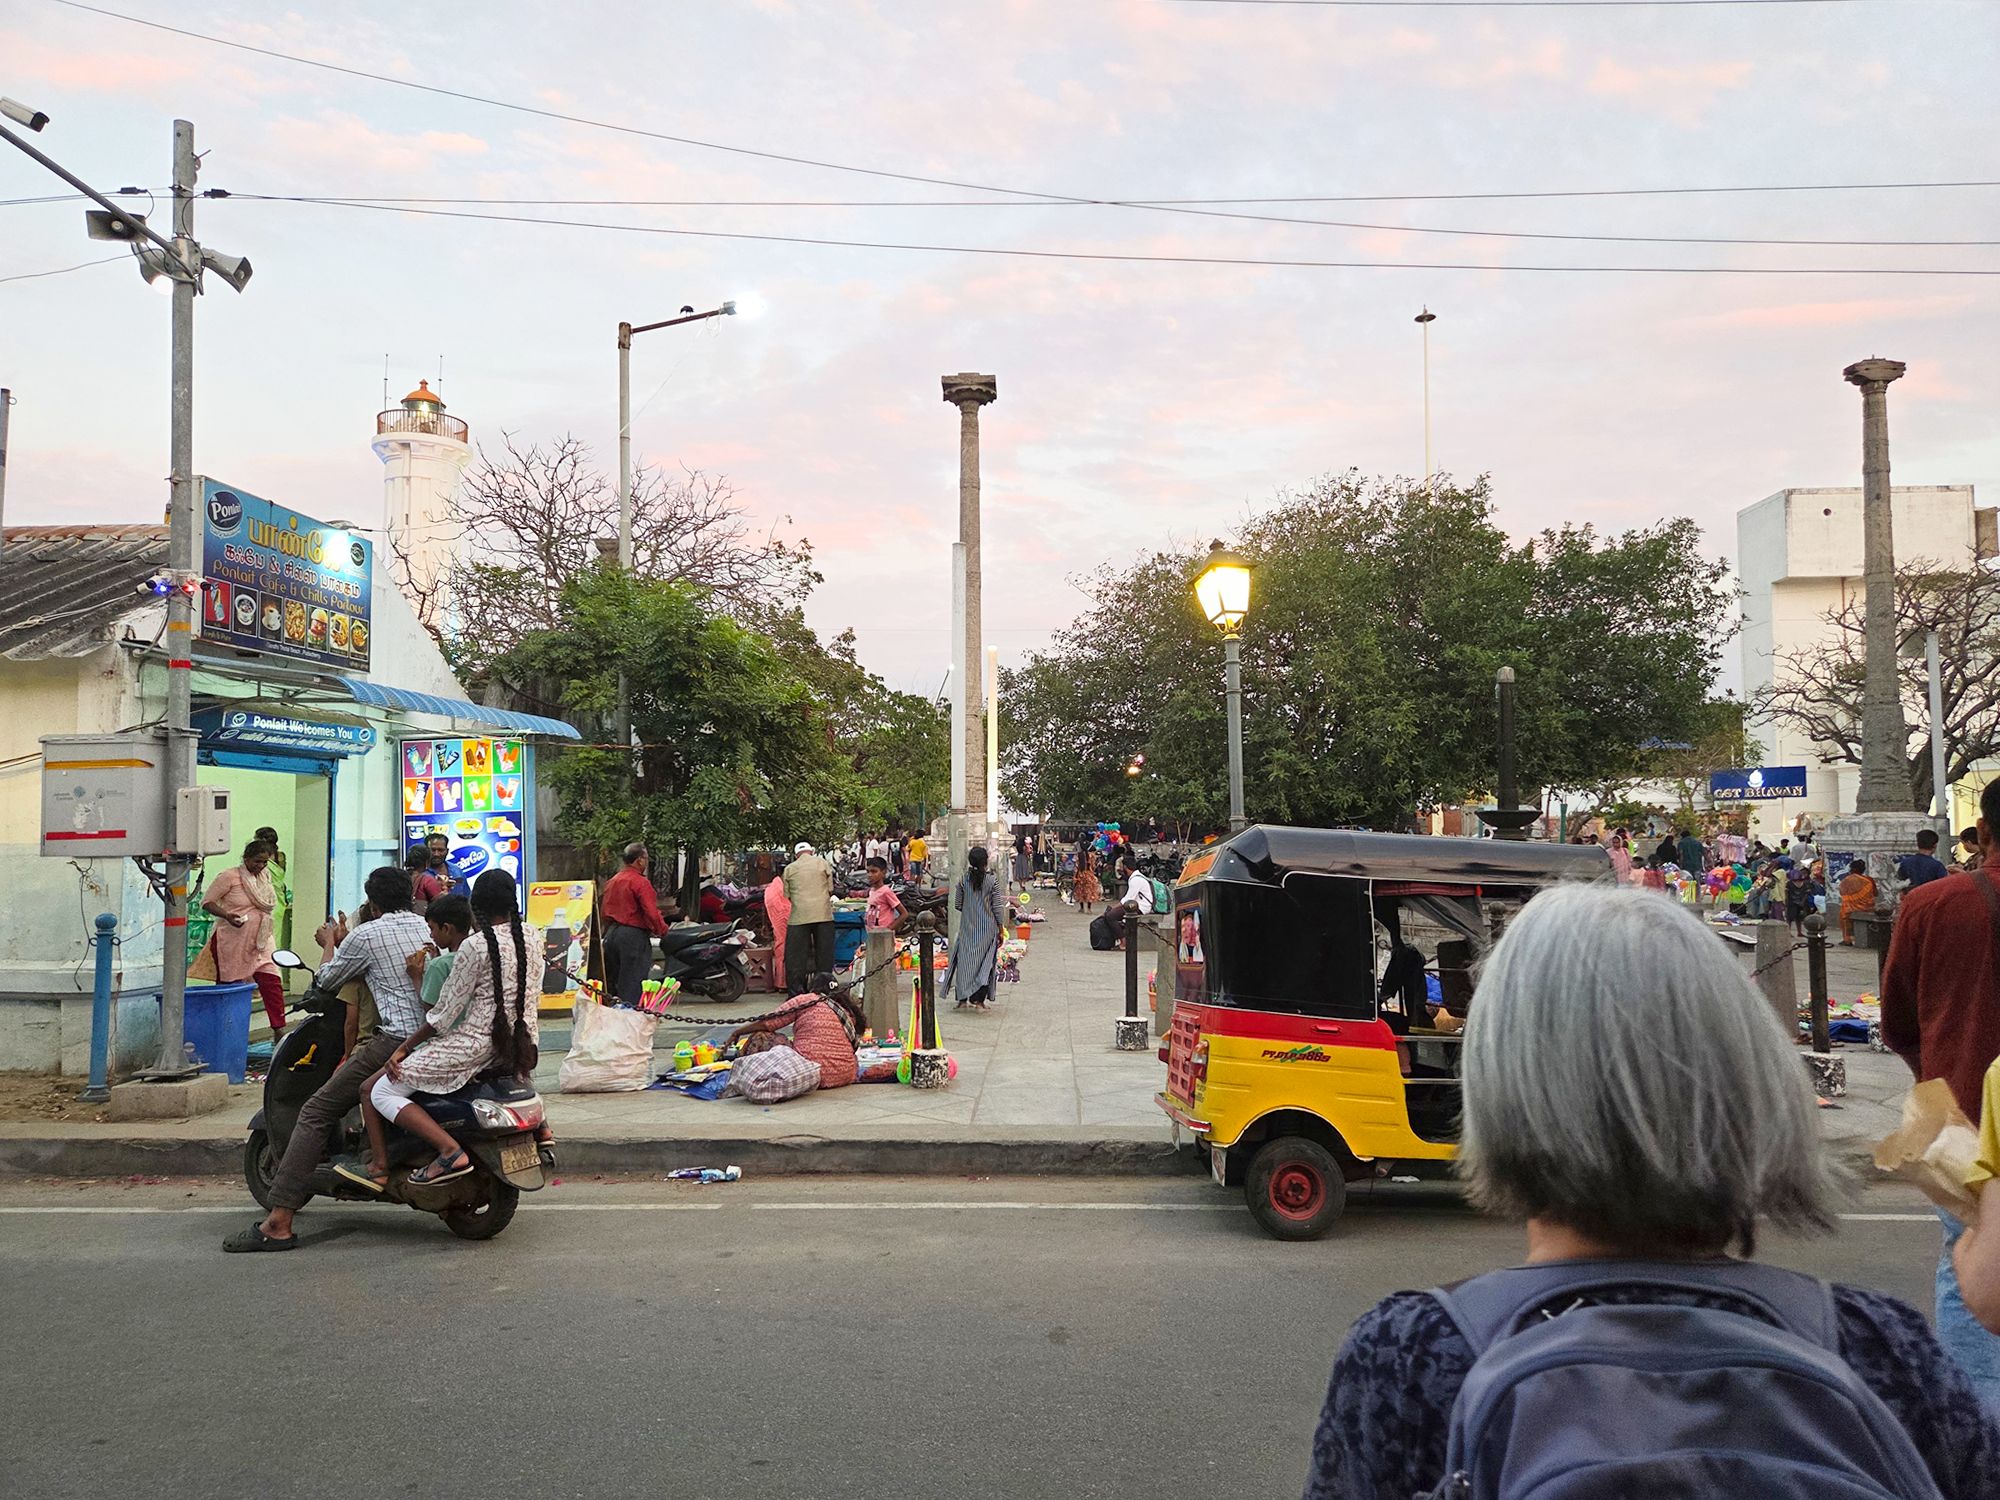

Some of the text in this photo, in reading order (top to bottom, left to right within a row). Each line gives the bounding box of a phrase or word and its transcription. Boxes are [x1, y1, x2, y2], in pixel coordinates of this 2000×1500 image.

[269, 554, 280, 574] &
[213, 560, 256, 586] Ponlait
[259, 573, 286, 594] Cafe
[300, 586, 328, 605] Chills
[331, 595, 365, 616] Parlour
[253, 715, 353, 740] Ponlait Welcomes You
